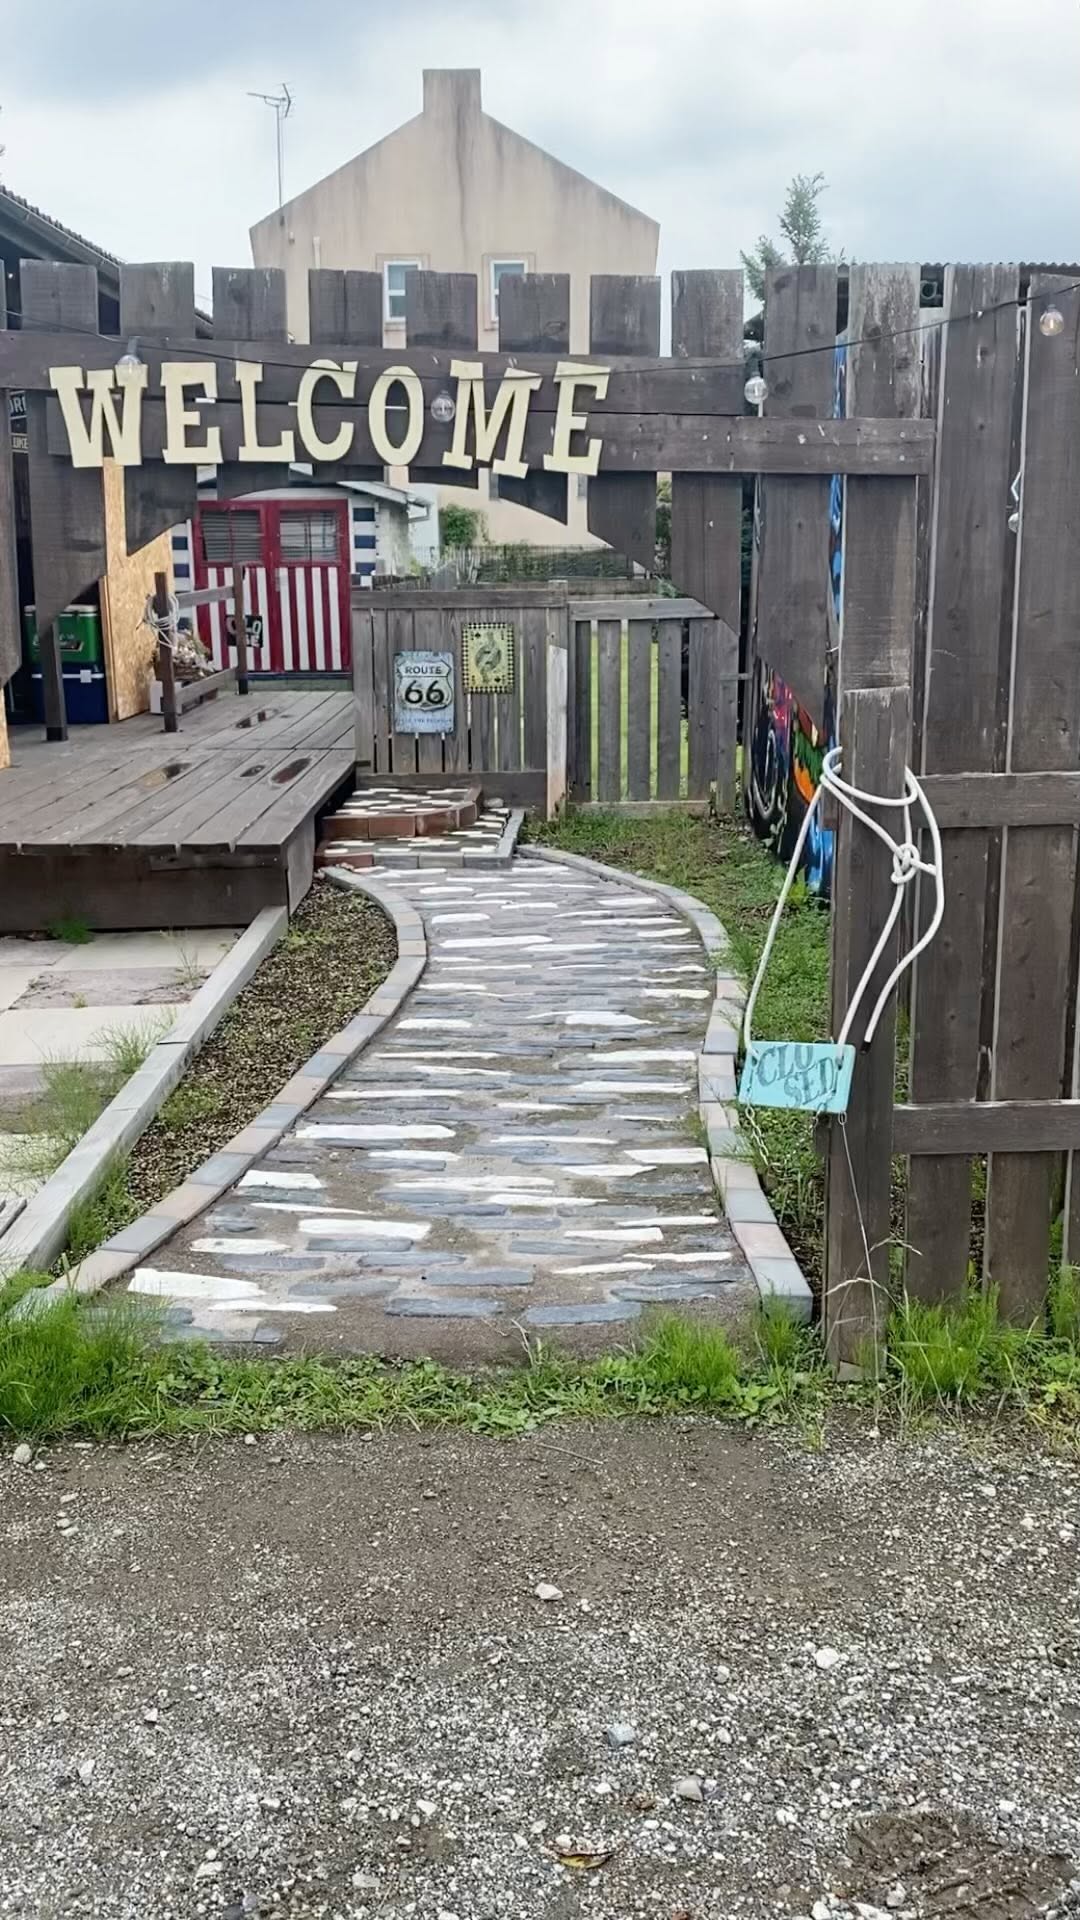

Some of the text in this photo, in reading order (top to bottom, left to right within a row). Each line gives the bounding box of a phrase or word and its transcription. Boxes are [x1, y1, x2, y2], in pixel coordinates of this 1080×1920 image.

[49, 360, 611, 478] WELCOME
[405, 665, 443, 675] ROUTE
[404, 680, 445, 705] 66
